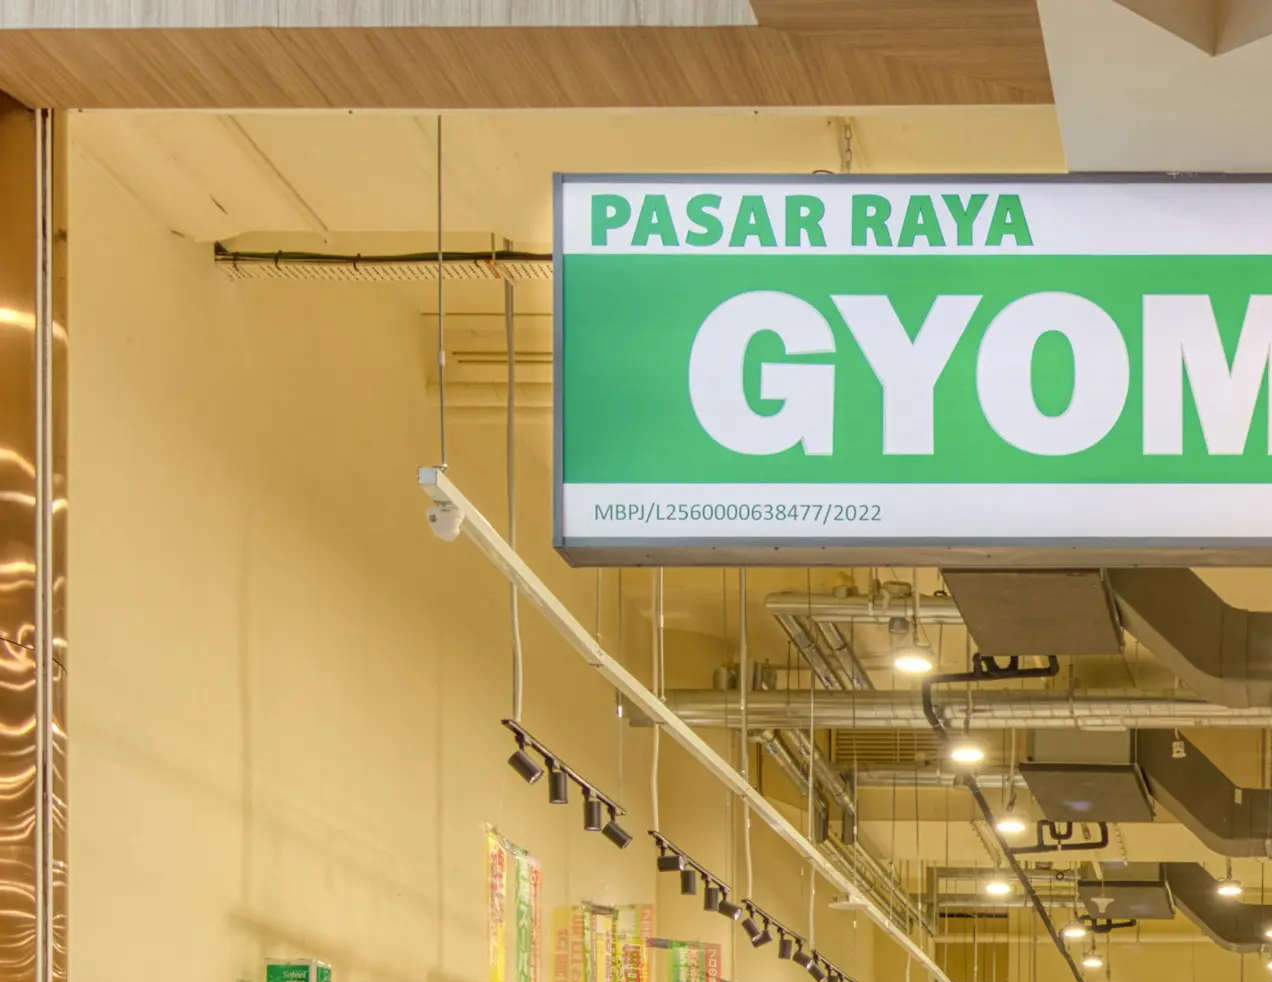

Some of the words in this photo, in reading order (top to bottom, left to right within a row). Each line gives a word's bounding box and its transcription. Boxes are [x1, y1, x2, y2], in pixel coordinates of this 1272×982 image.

[590, 193, 826, 247] PASAR
[851, 193, 1033, 247] RAYA
[594, 503, 881, 525] MBPJ/L2560000638477/2022
